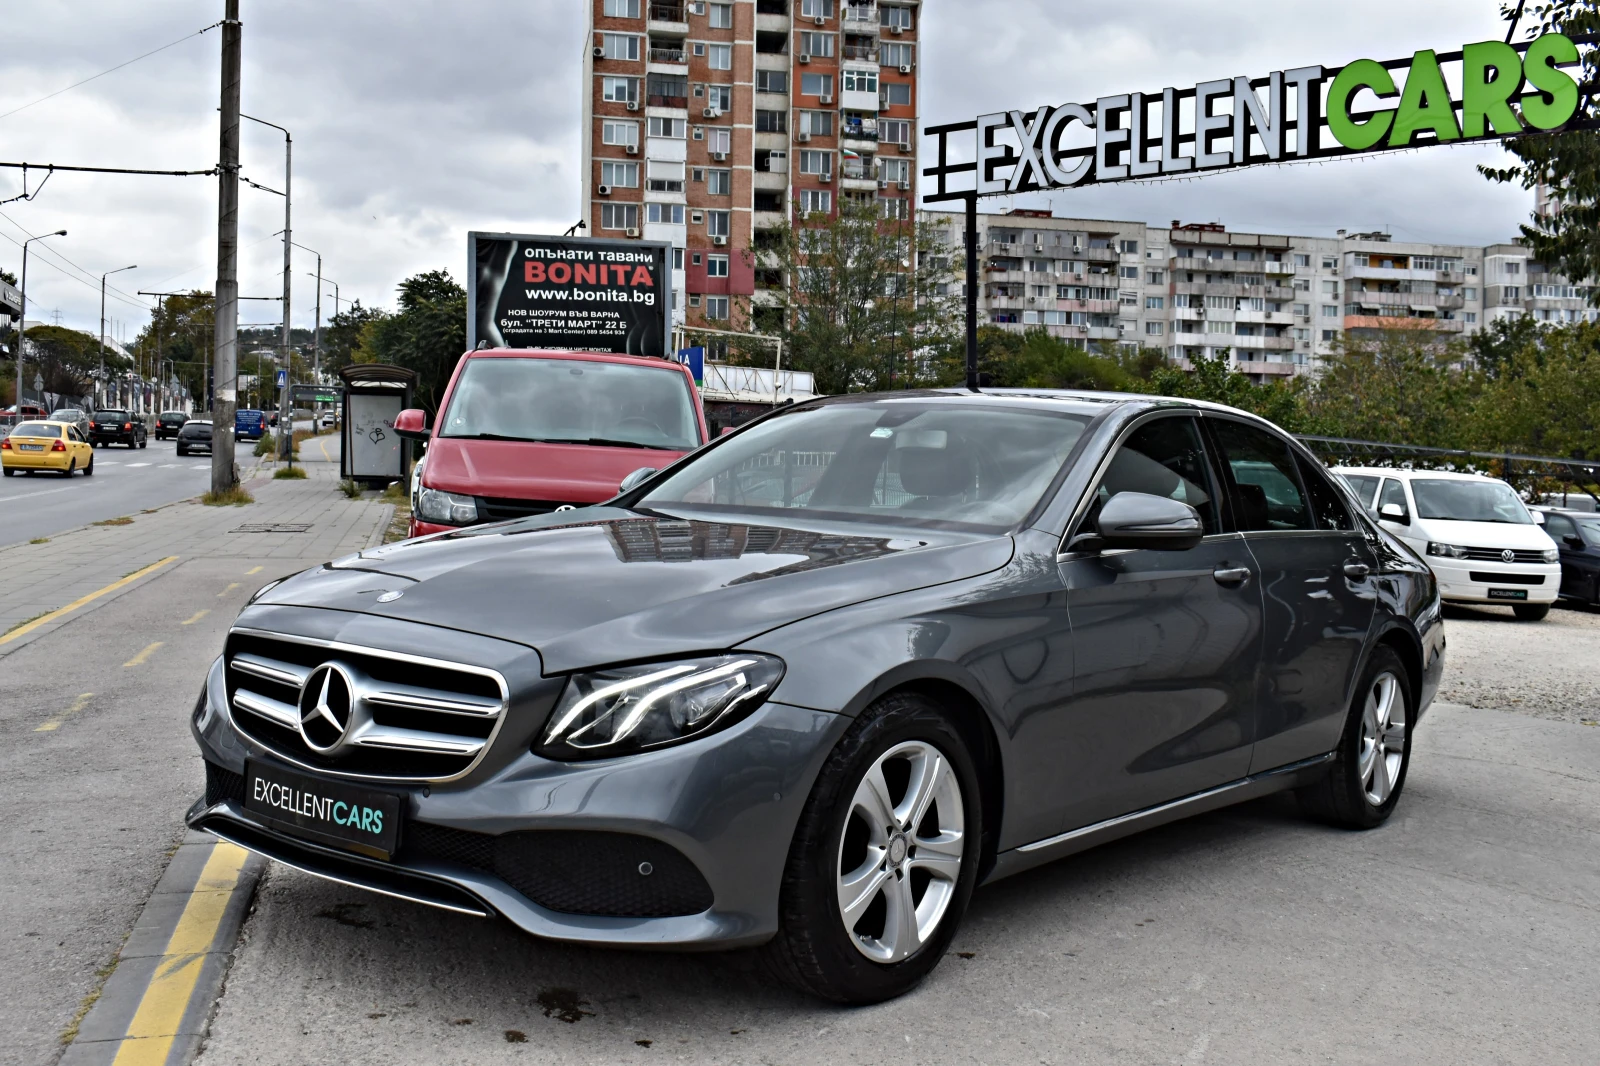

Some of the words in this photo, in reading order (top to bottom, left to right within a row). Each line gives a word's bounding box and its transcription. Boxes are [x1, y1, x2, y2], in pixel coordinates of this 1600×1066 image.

[976, 33, 1580, 195] EXCELLENTCARS
[524, 248, 594, 260] опънати
[598, 251, 653, 263] тавани
[525, 288, 655, 306] www.bonita.bg
[529, 309, 567, 317] ШОУРУМ
[569, 310, 588, 318] ВЪВ
[500, 319, 523, 328] бул.
[605, 321, 617, 329] 22
[619, 321, 627, 329] Б
[253, 777, 383, 834] EXCELLENTCARS
